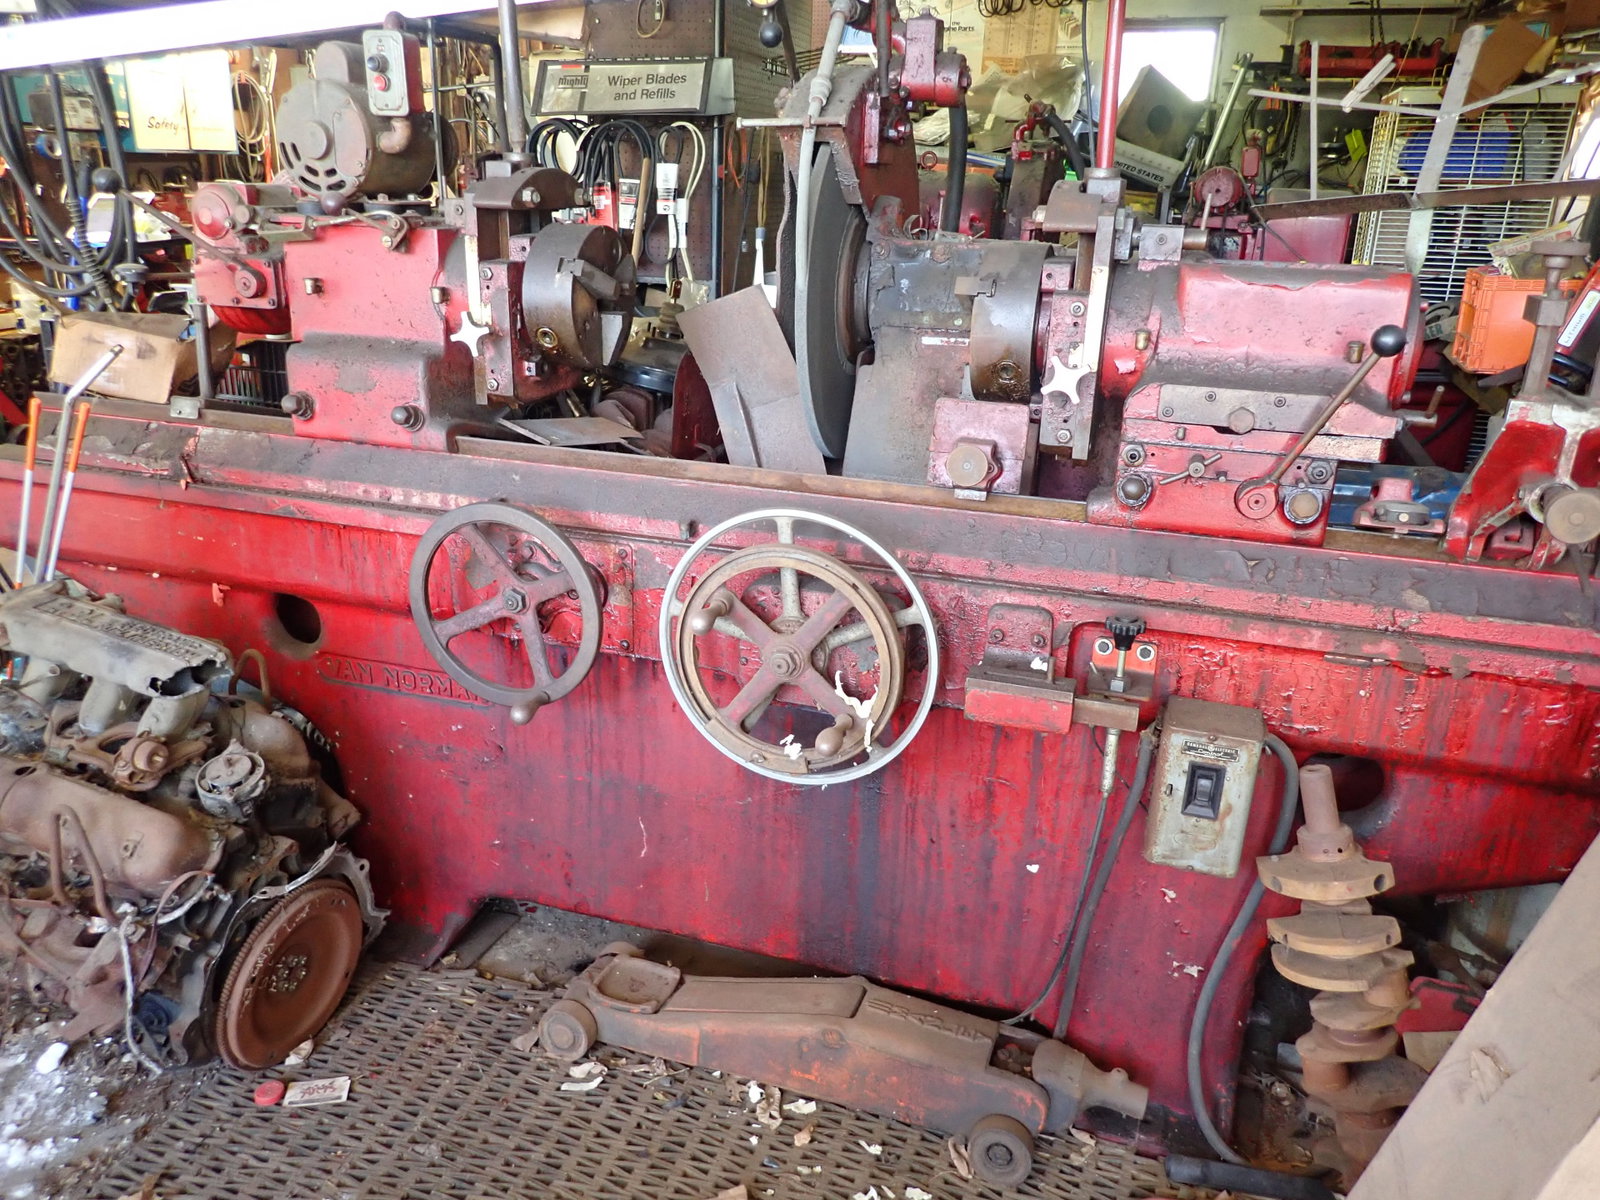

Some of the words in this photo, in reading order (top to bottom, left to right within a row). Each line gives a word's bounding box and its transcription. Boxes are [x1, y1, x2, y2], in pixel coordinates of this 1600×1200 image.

[607, 75, 643, 89] Wiper
[646, 73, 687, 85] Blades
[614, 89, 637, 101] and
[640, 88, 676, 100] Refills
[1137, 168, 1164, 182] STATES
[325, 656, 374, 685] VAN
